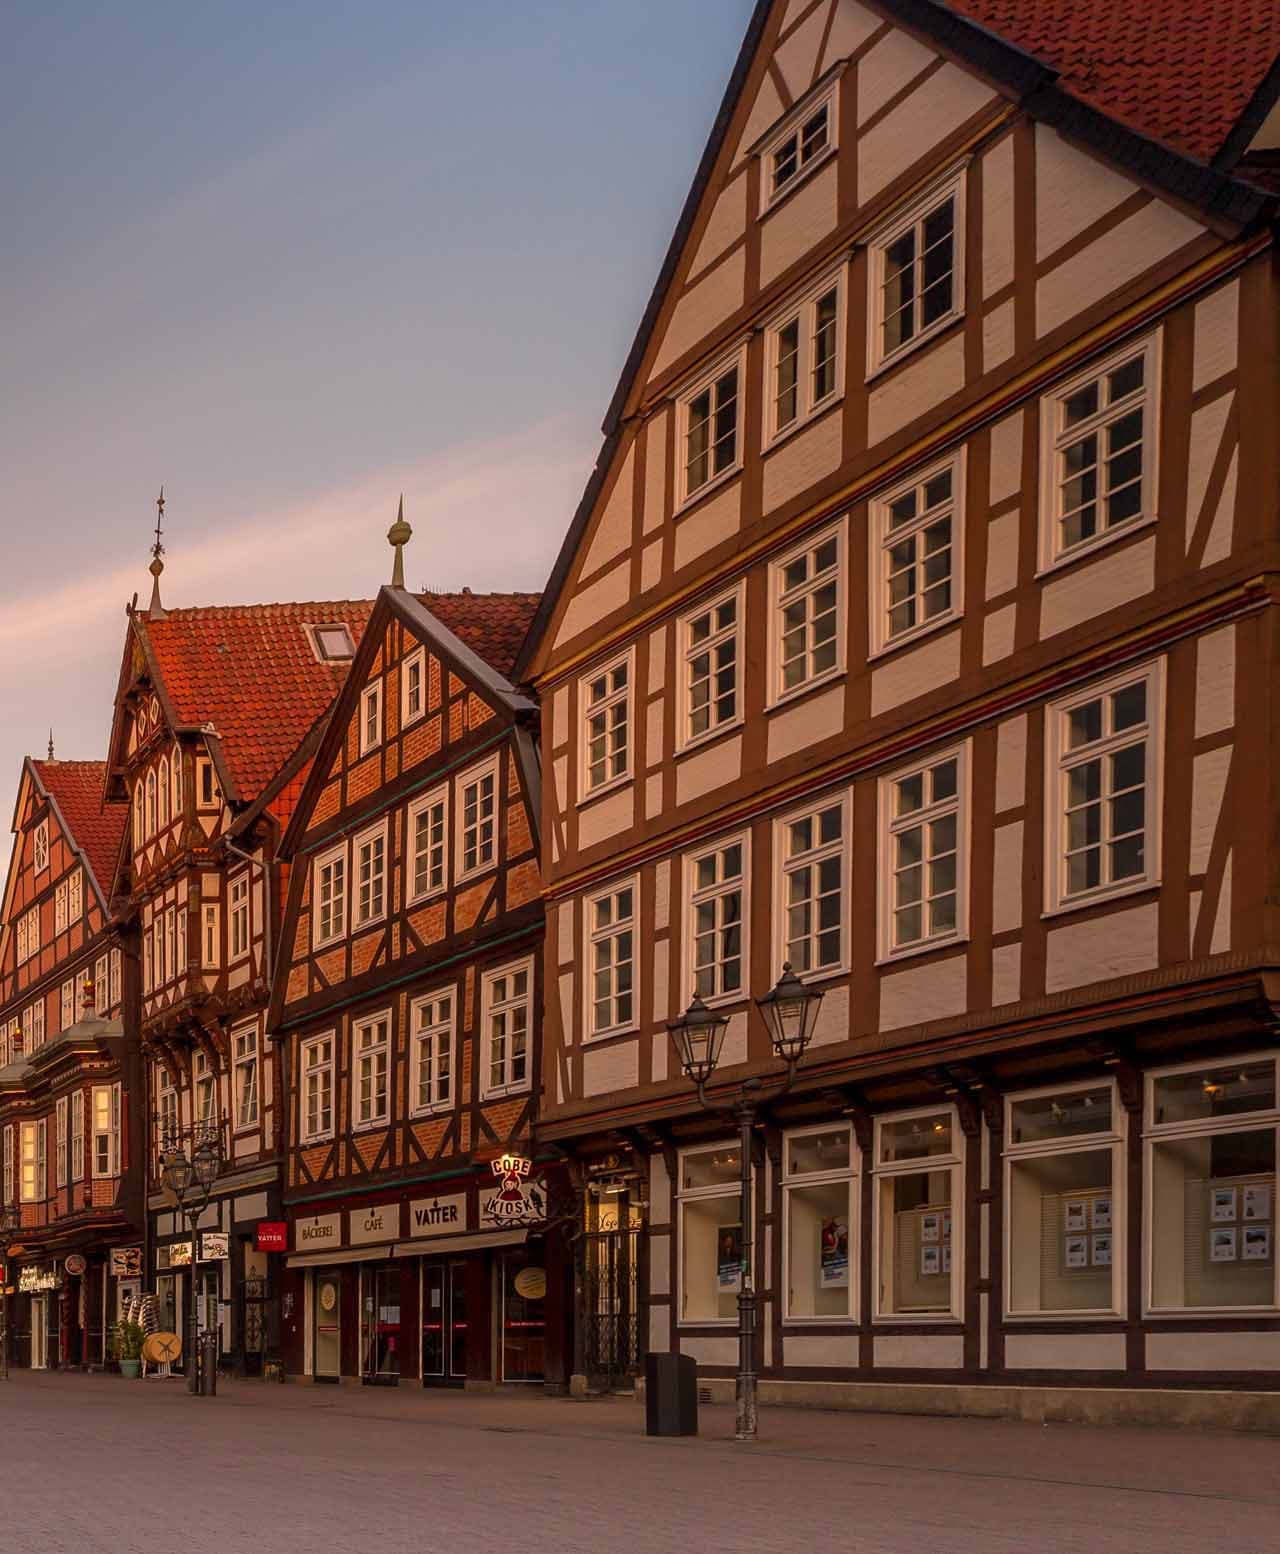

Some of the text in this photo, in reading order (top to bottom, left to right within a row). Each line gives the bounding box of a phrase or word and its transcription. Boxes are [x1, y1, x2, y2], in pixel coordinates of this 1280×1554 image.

[493, 1159, 530, 1173] COBE
[489, 1198, 533, 1215] KIOSK
[415, 1204, 458, 1227] VATTER
[364, 1216, 385, 1232] CAFÉ
[257, 1233, 282, 1241] VATTER
